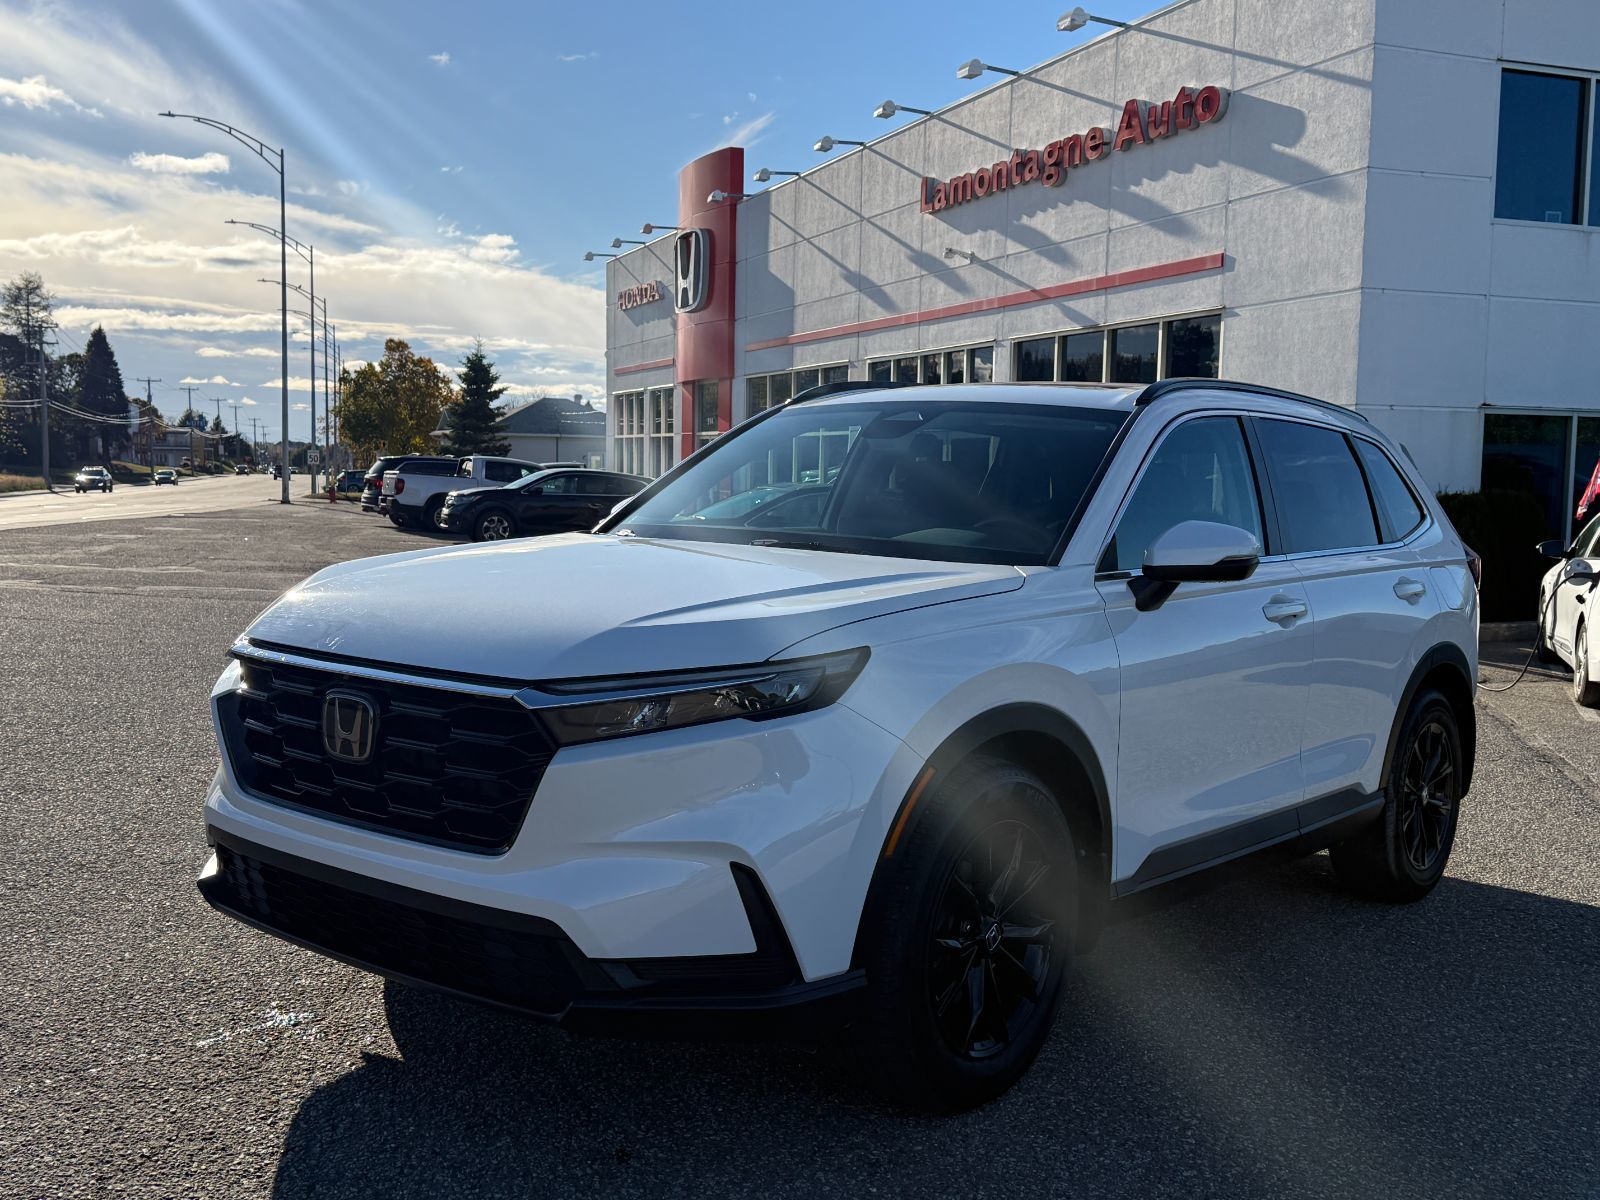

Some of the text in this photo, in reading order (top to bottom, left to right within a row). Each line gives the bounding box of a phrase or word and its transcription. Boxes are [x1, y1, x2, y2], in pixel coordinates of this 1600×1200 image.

[919, 86, 1225, 214] Lamontagne Auto
[618, 280, 661, 311] HONDA
[309, 454, 319, 463] 50
